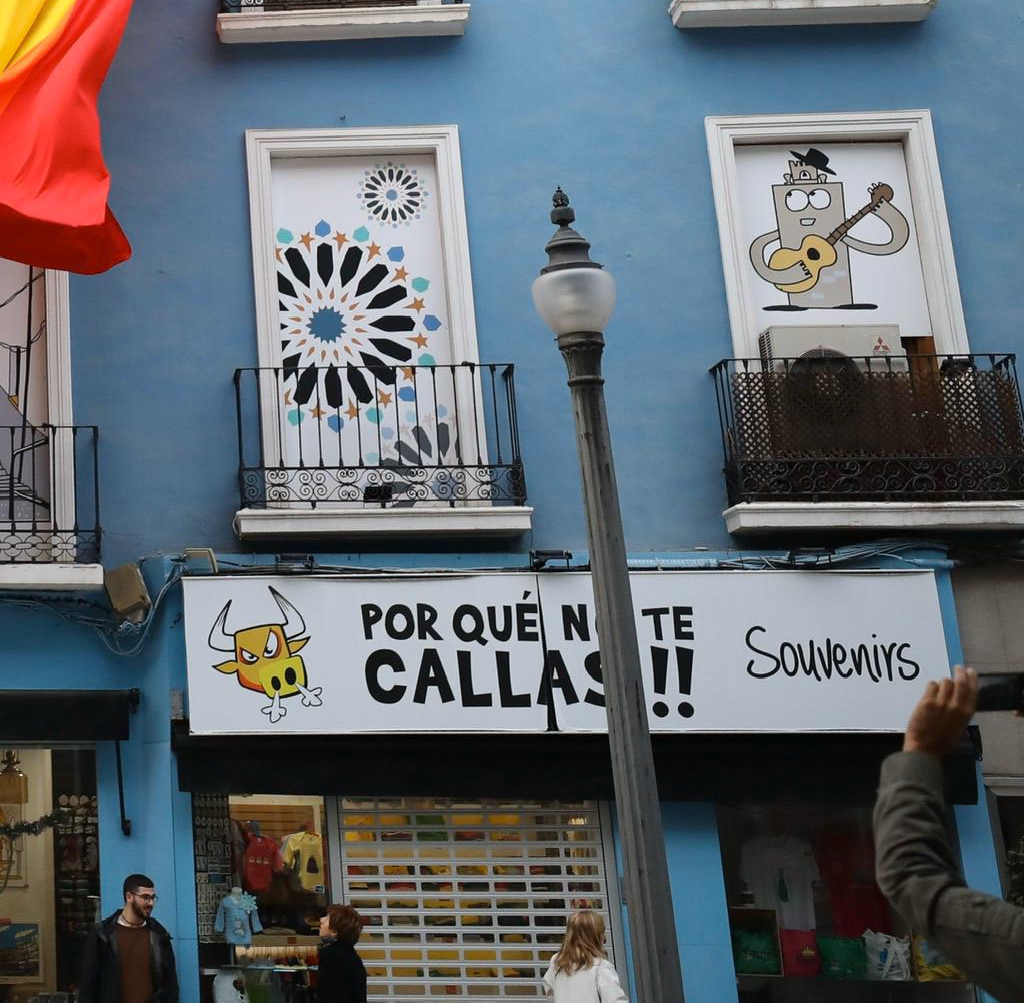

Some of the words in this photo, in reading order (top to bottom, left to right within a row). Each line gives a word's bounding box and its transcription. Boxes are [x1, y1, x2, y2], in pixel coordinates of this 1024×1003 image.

[360, 602, 444, 641] POR
[452, 590, 539, 647] QUÉ
[561, 603, 599, 642] N
[641, 605, 695, 641] TE
[364, 648, 606, 708] CALLAS
[745, 625, 921, 683] Souvenirs
